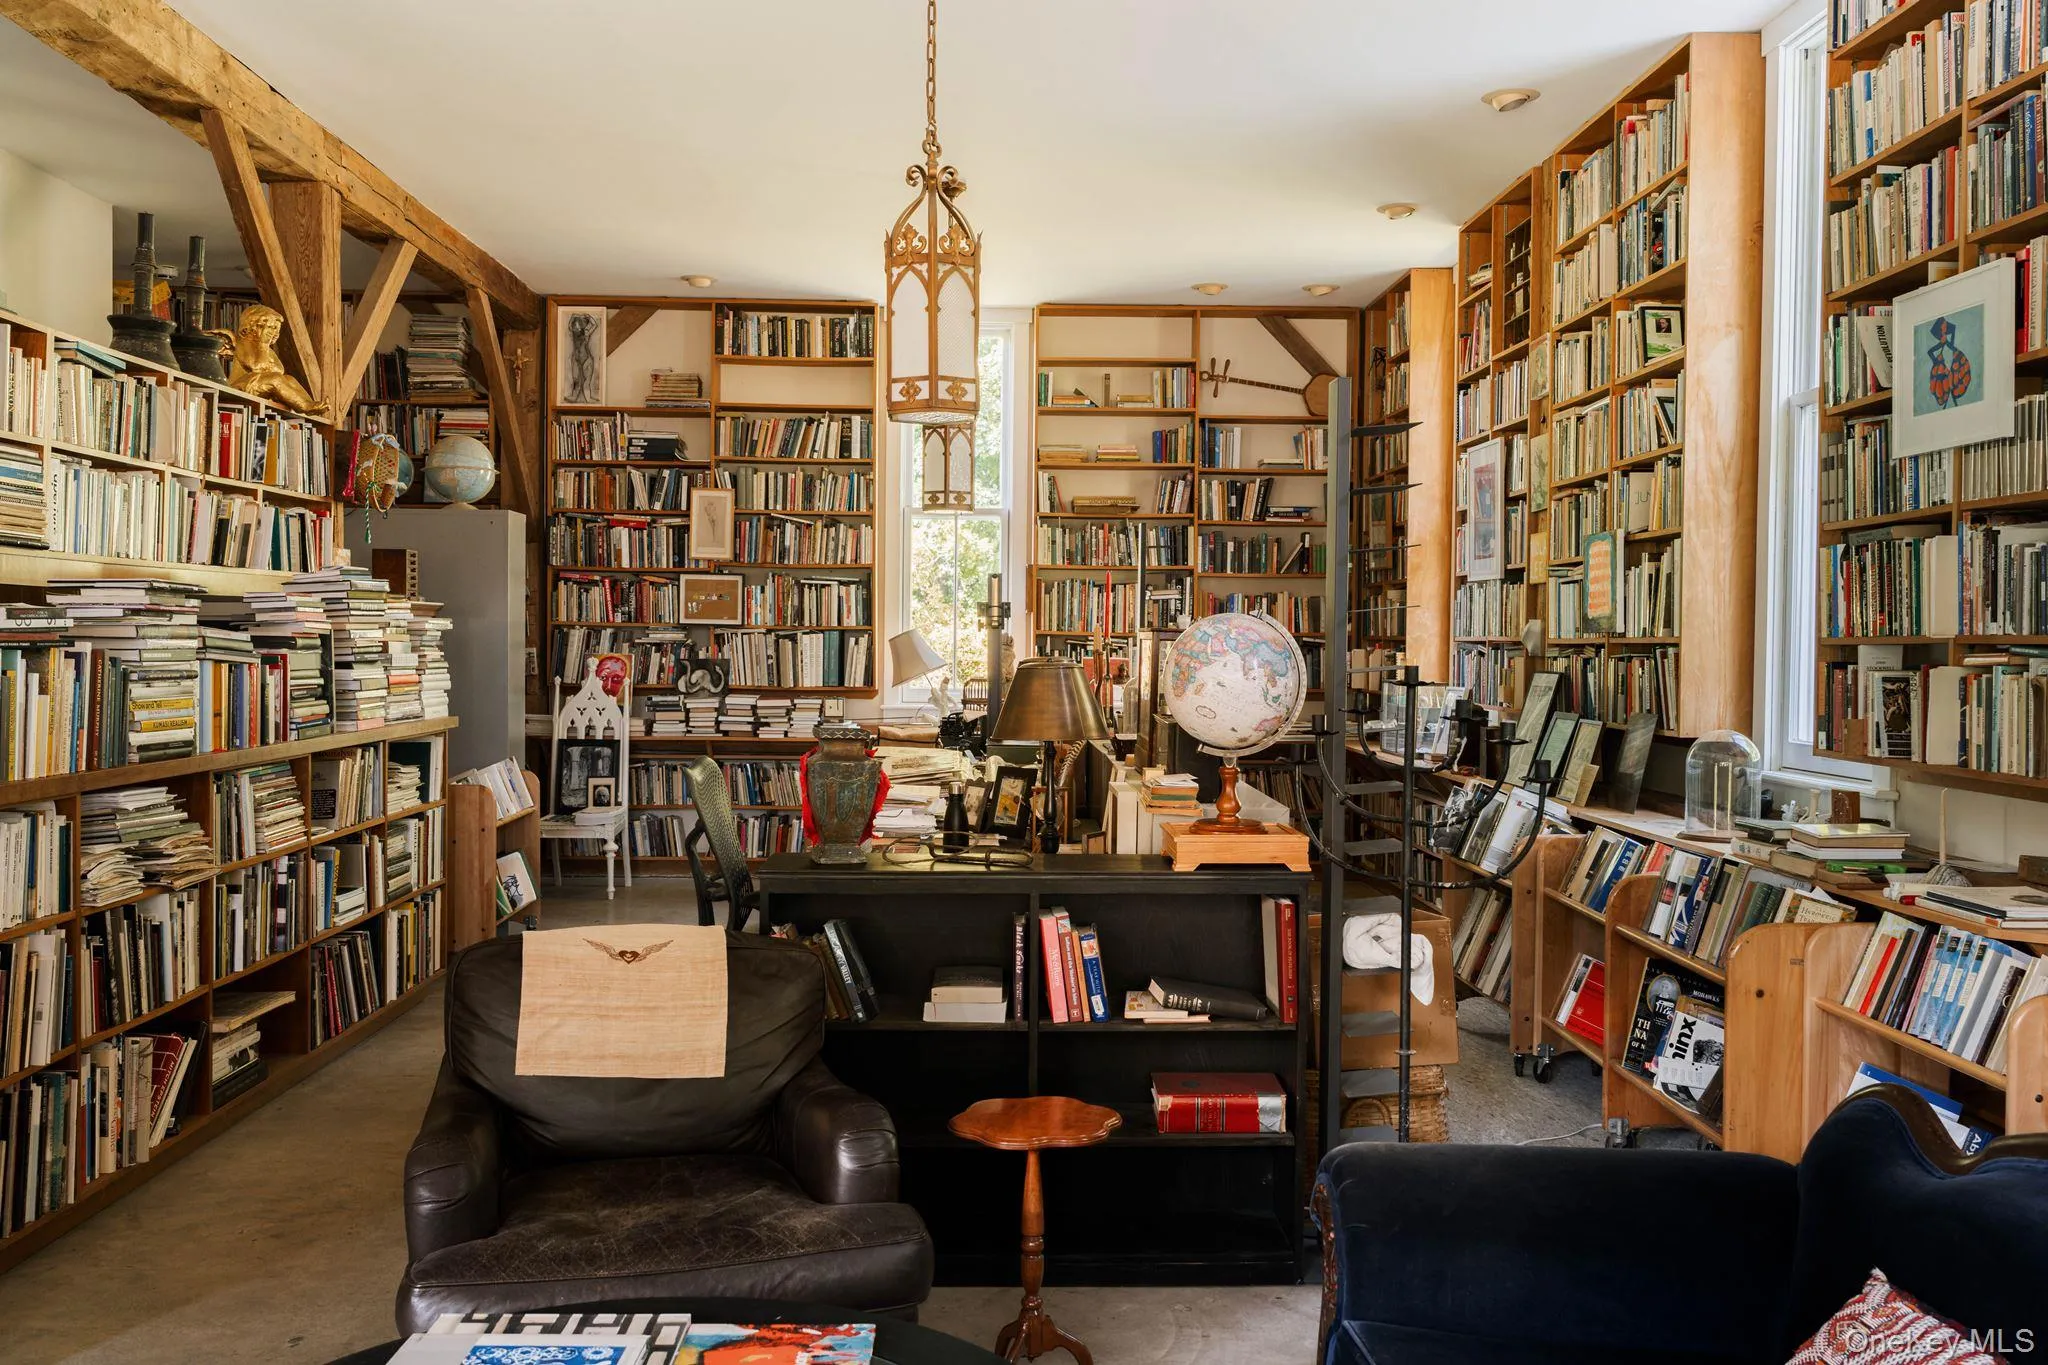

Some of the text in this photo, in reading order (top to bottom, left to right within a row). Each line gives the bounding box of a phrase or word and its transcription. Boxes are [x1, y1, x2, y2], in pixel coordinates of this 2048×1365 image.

[95, 659, 103, 702] CATHERINE
[170, 719, 188, 727] REALISM
[1015, 926, 1024, 947] Black
[1015, 949, 1025, 974] Smoke
[841, 964, 853, 985] VALLEY
[1693, 989, 1720, 1002] MOHAWKS
[150, 1061, 175, 1118] MITCH EPSTEIN
